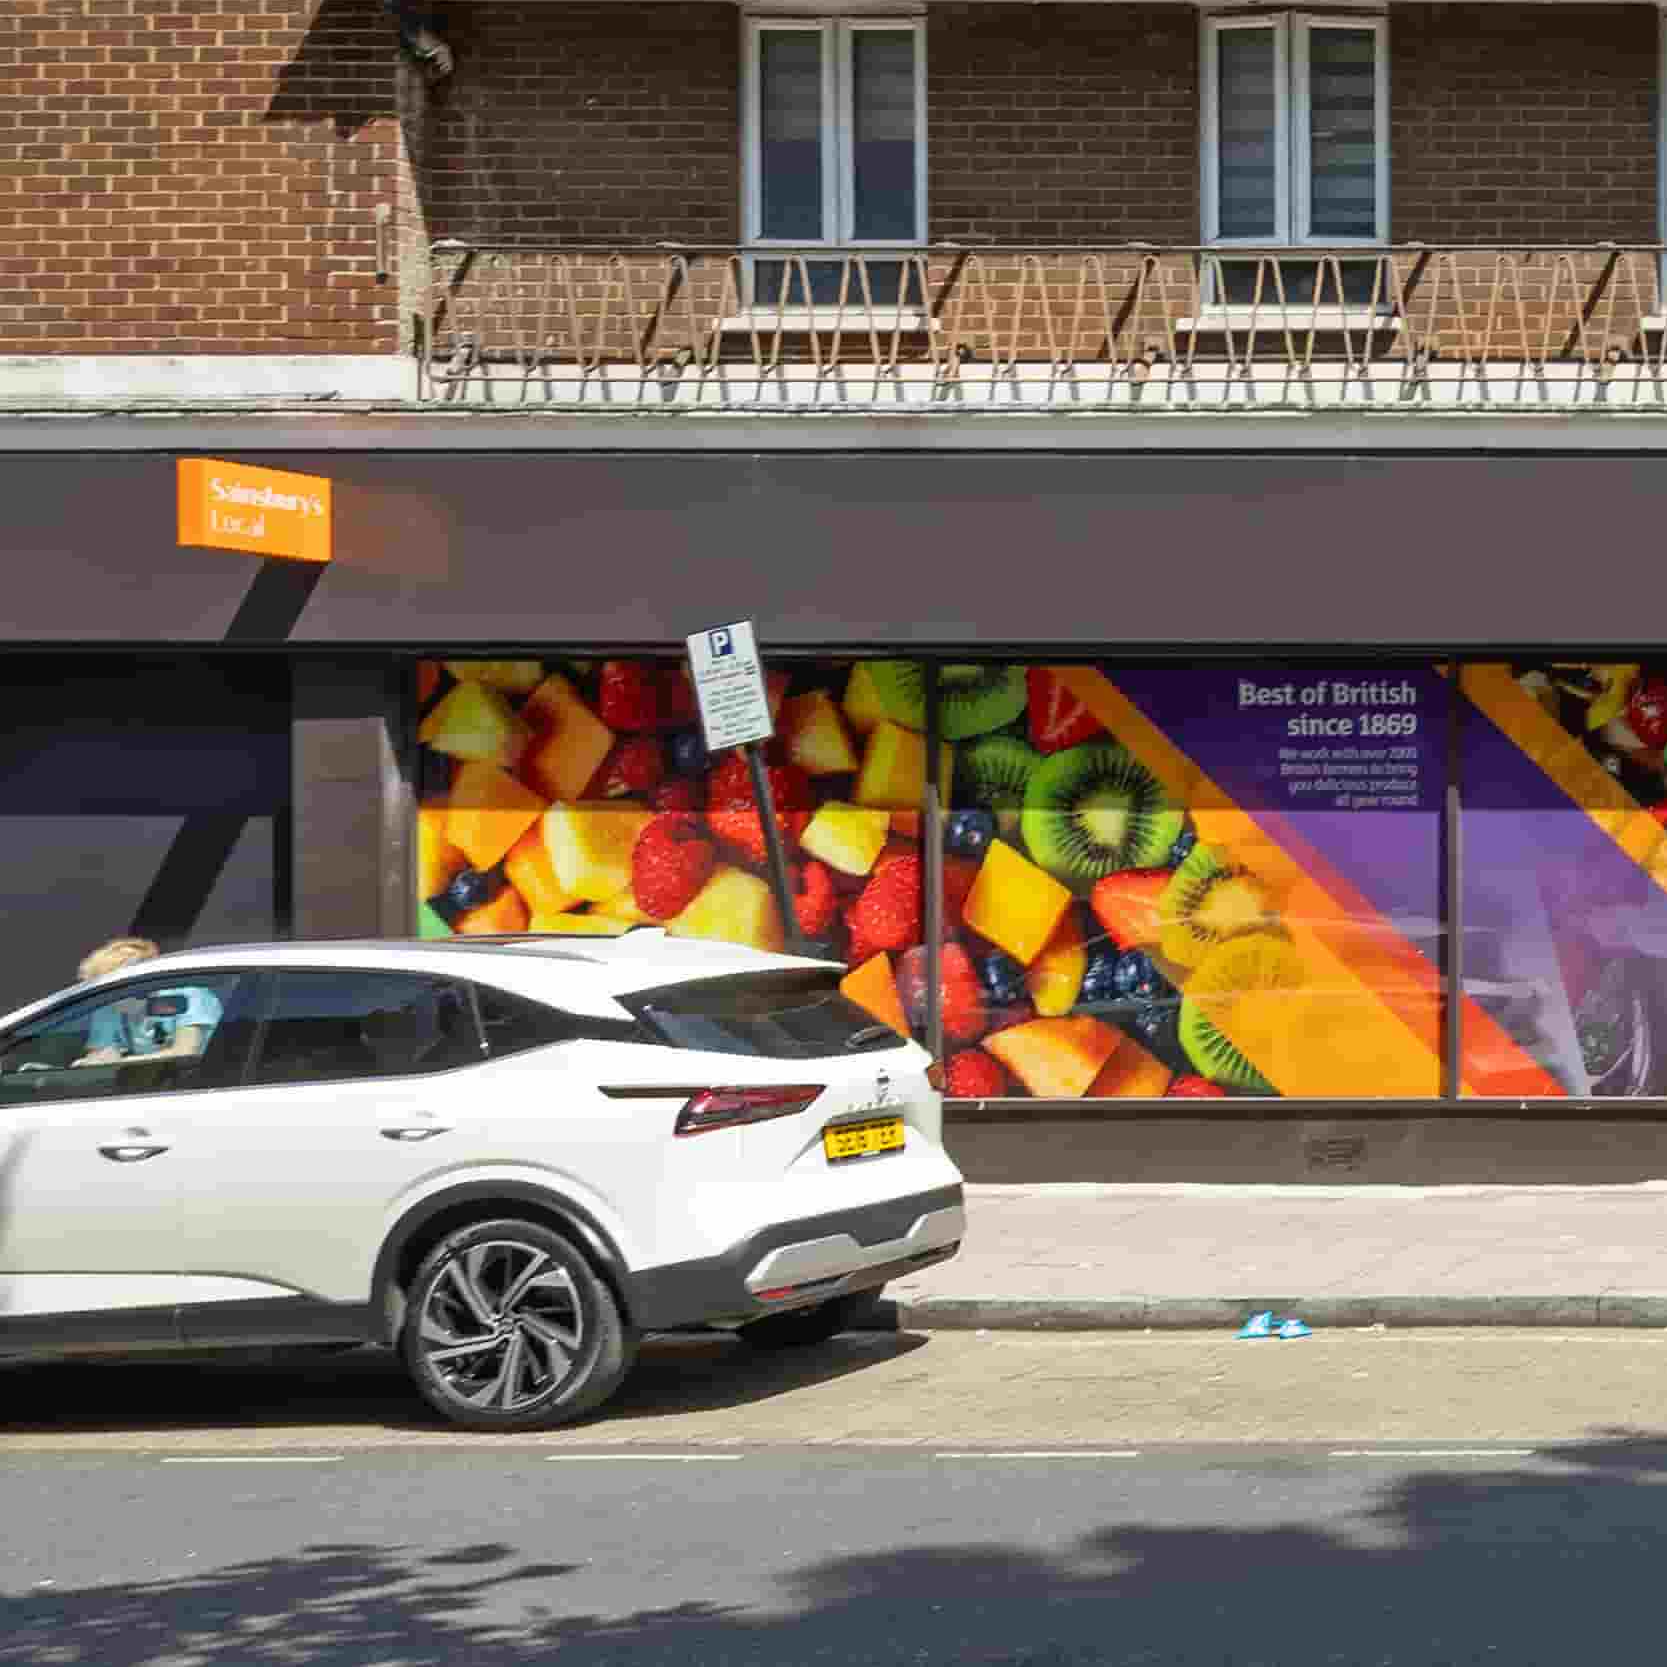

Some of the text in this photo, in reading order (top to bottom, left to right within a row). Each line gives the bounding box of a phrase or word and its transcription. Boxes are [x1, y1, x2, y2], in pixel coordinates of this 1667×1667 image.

[208, 477, 325, 518] Sainsbury's
[210, 509, 265, 538] Local
[711, 631, 729, 656] P
[1238, 680, 1417, 707] Best of British
[1287, 713, 1417, 736] since 1869
